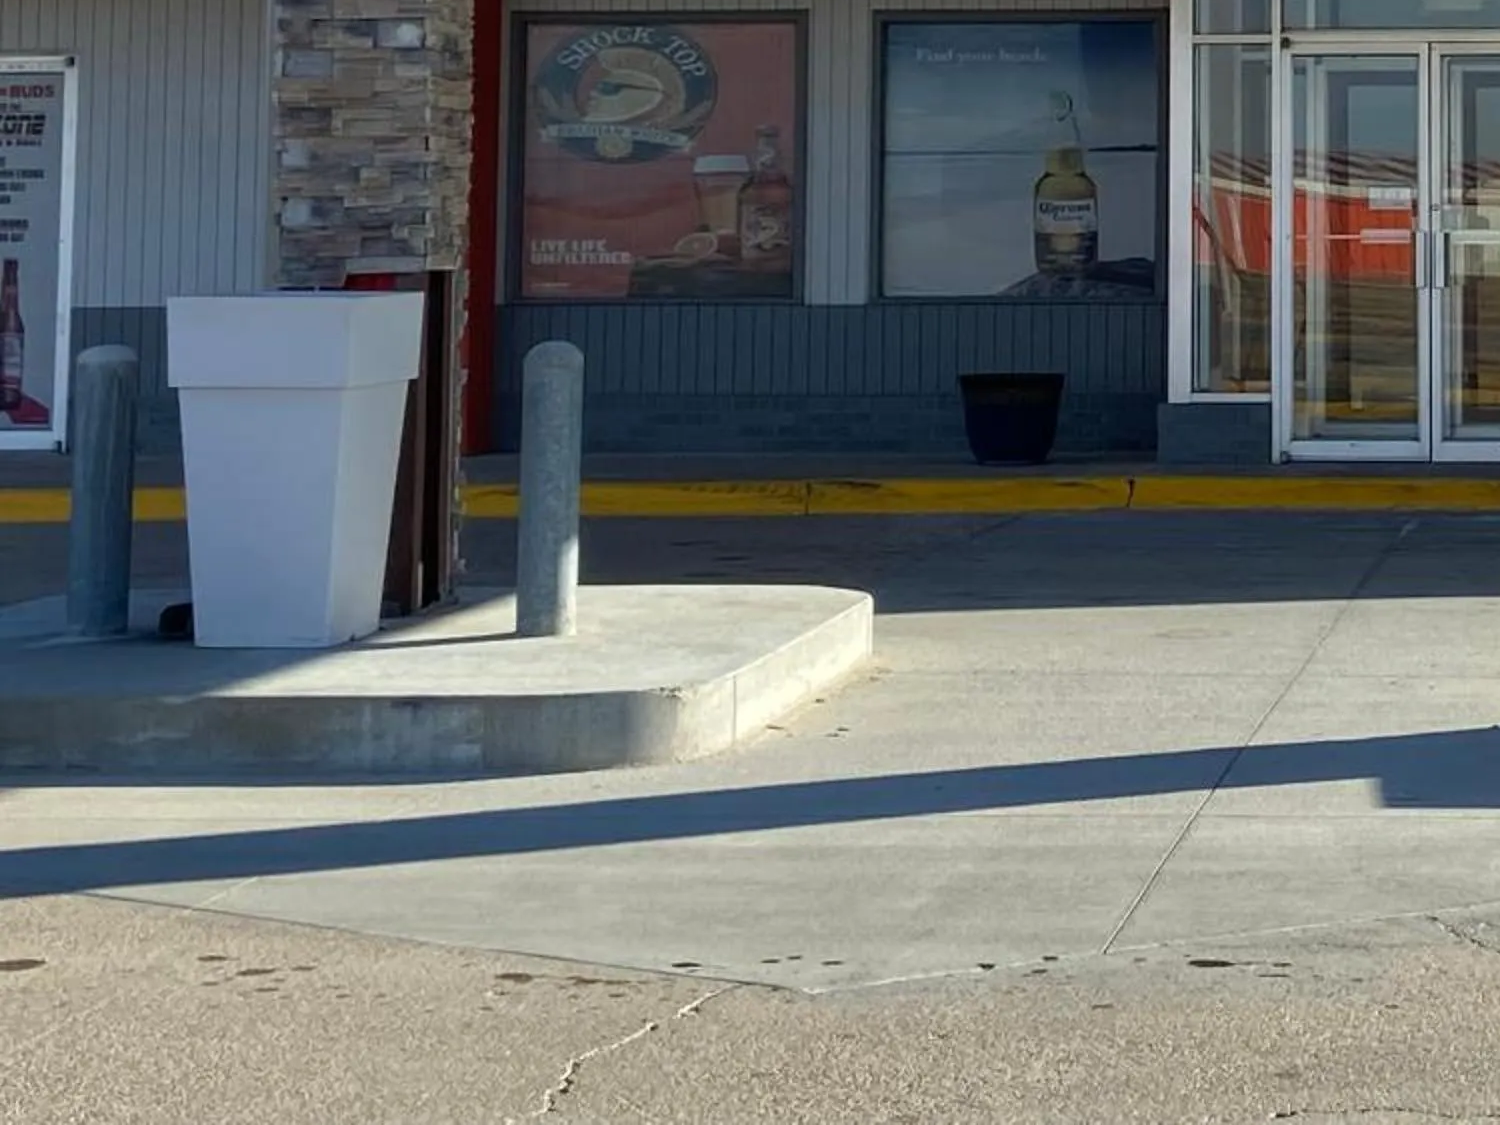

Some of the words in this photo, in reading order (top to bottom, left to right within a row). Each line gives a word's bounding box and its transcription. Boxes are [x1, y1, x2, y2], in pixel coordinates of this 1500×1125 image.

[557, 26, 656, 70] SHOCK
[663, 35, 707, 76] TOP
[531, 239, 567, 252] LIVE
[571, 238, 607, 252] LIFE
